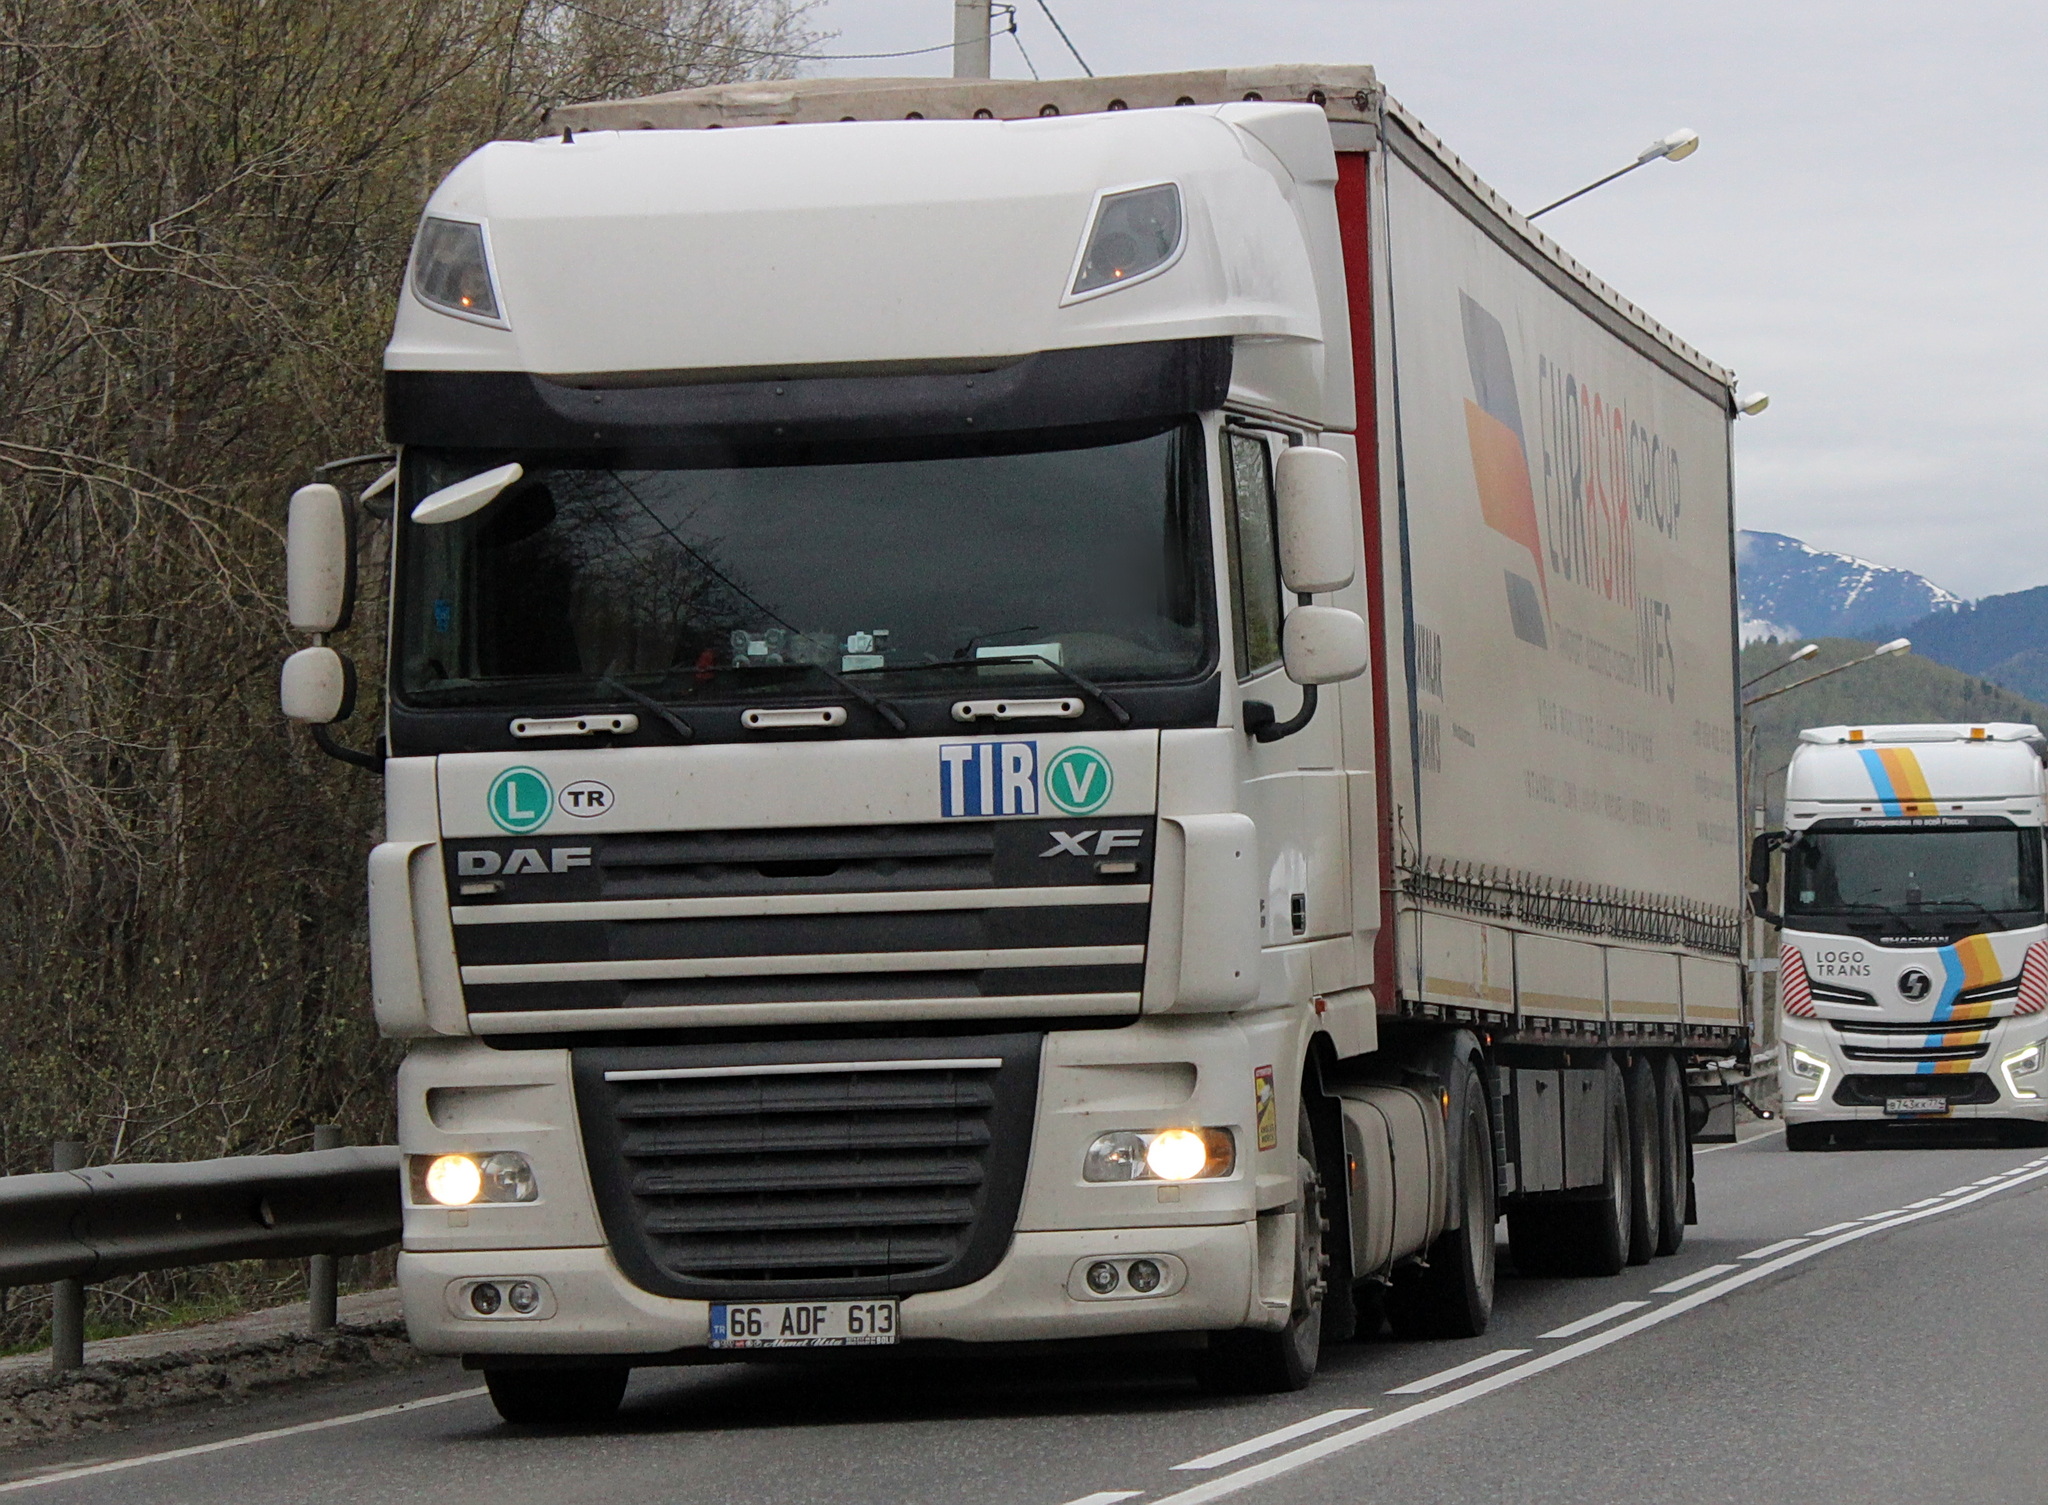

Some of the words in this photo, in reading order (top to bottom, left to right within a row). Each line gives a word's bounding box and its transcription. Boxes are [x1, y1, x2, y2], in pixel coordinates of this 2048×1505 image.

[1539, 354, 1633, 610] EURASIA
[1630, 419, 1681, 541] GROUP
[941, 743, 1035, 816] TIR
[1062, 762, 1097, 803] V
[507, 781, 535, 819] L
[567, 791, 605, 807] TR
[1038, 829, 1144, 857] XF
[457, 847, 592, 876] DAF
[1880, 936, 1949, 944] SHACMAN
[1817, 951, 1864, 963] LOGO
[1817, 965, 1871, 976] TRANS
[713, 1325, 726, 1334] TR
[731, 1308, 761, 1336] 66
[780, 1306, 827, 1335] ADF
[848, 1304, 892, 1334] 613
